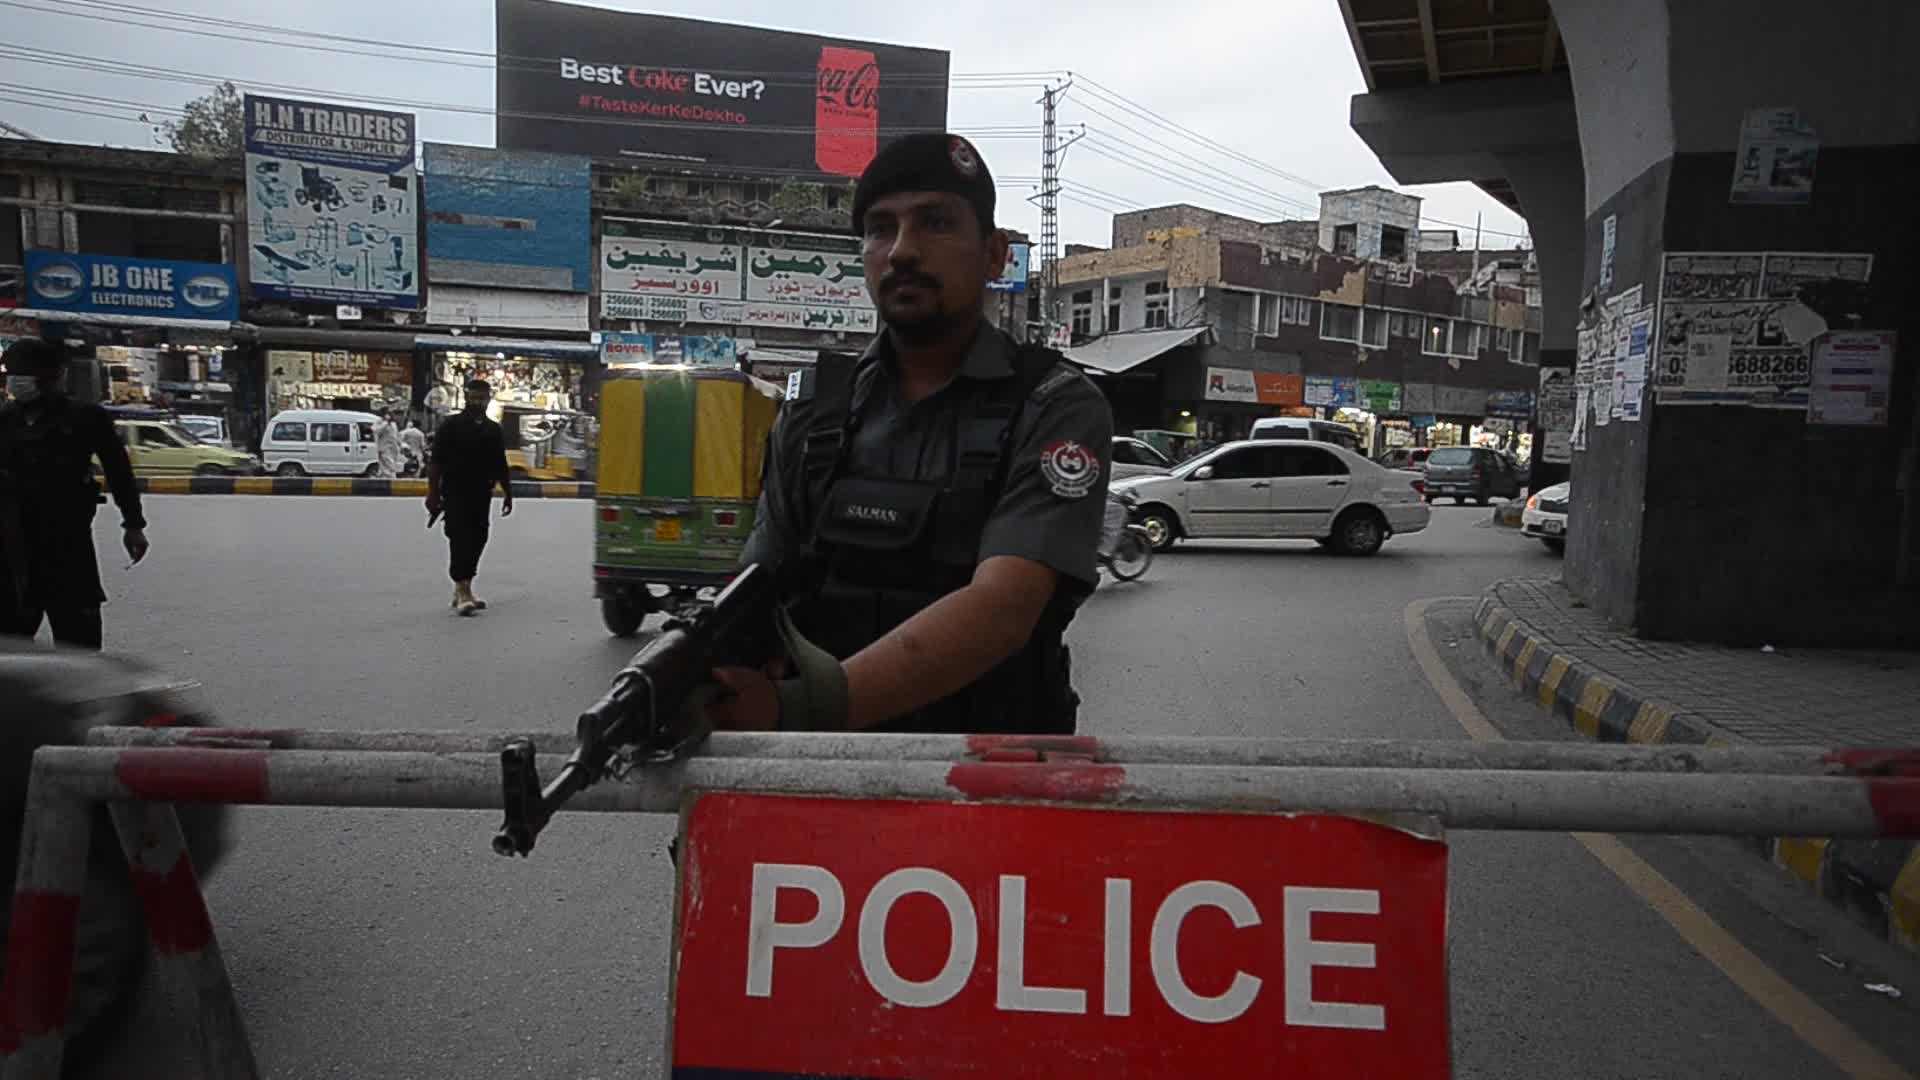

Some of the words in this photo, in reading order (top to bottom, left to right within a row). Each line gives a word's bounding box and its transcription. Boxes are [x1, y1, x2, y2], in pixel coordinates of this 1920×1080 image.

[560, 57, 624, 85] Best
[628, 66, 689, 93] Coke
[694, 72, 765, 100] Ever?
[255, 102, 294, 129] H.N
[300, 107, 407, 142] TRADERS
[579, 95, 747, 124] #TasteKerKeDekho
[266, 131, 335, 147] DISTRIBUTOR
[351, 141, 396, 153] SUPPLIER
[91, 264, 120, 288] JB
[126, 266, 174, 291] ONE
[92, 292, 175, 309] ELECTRONICS
[745, 863, 1386, 1031] POLICE
